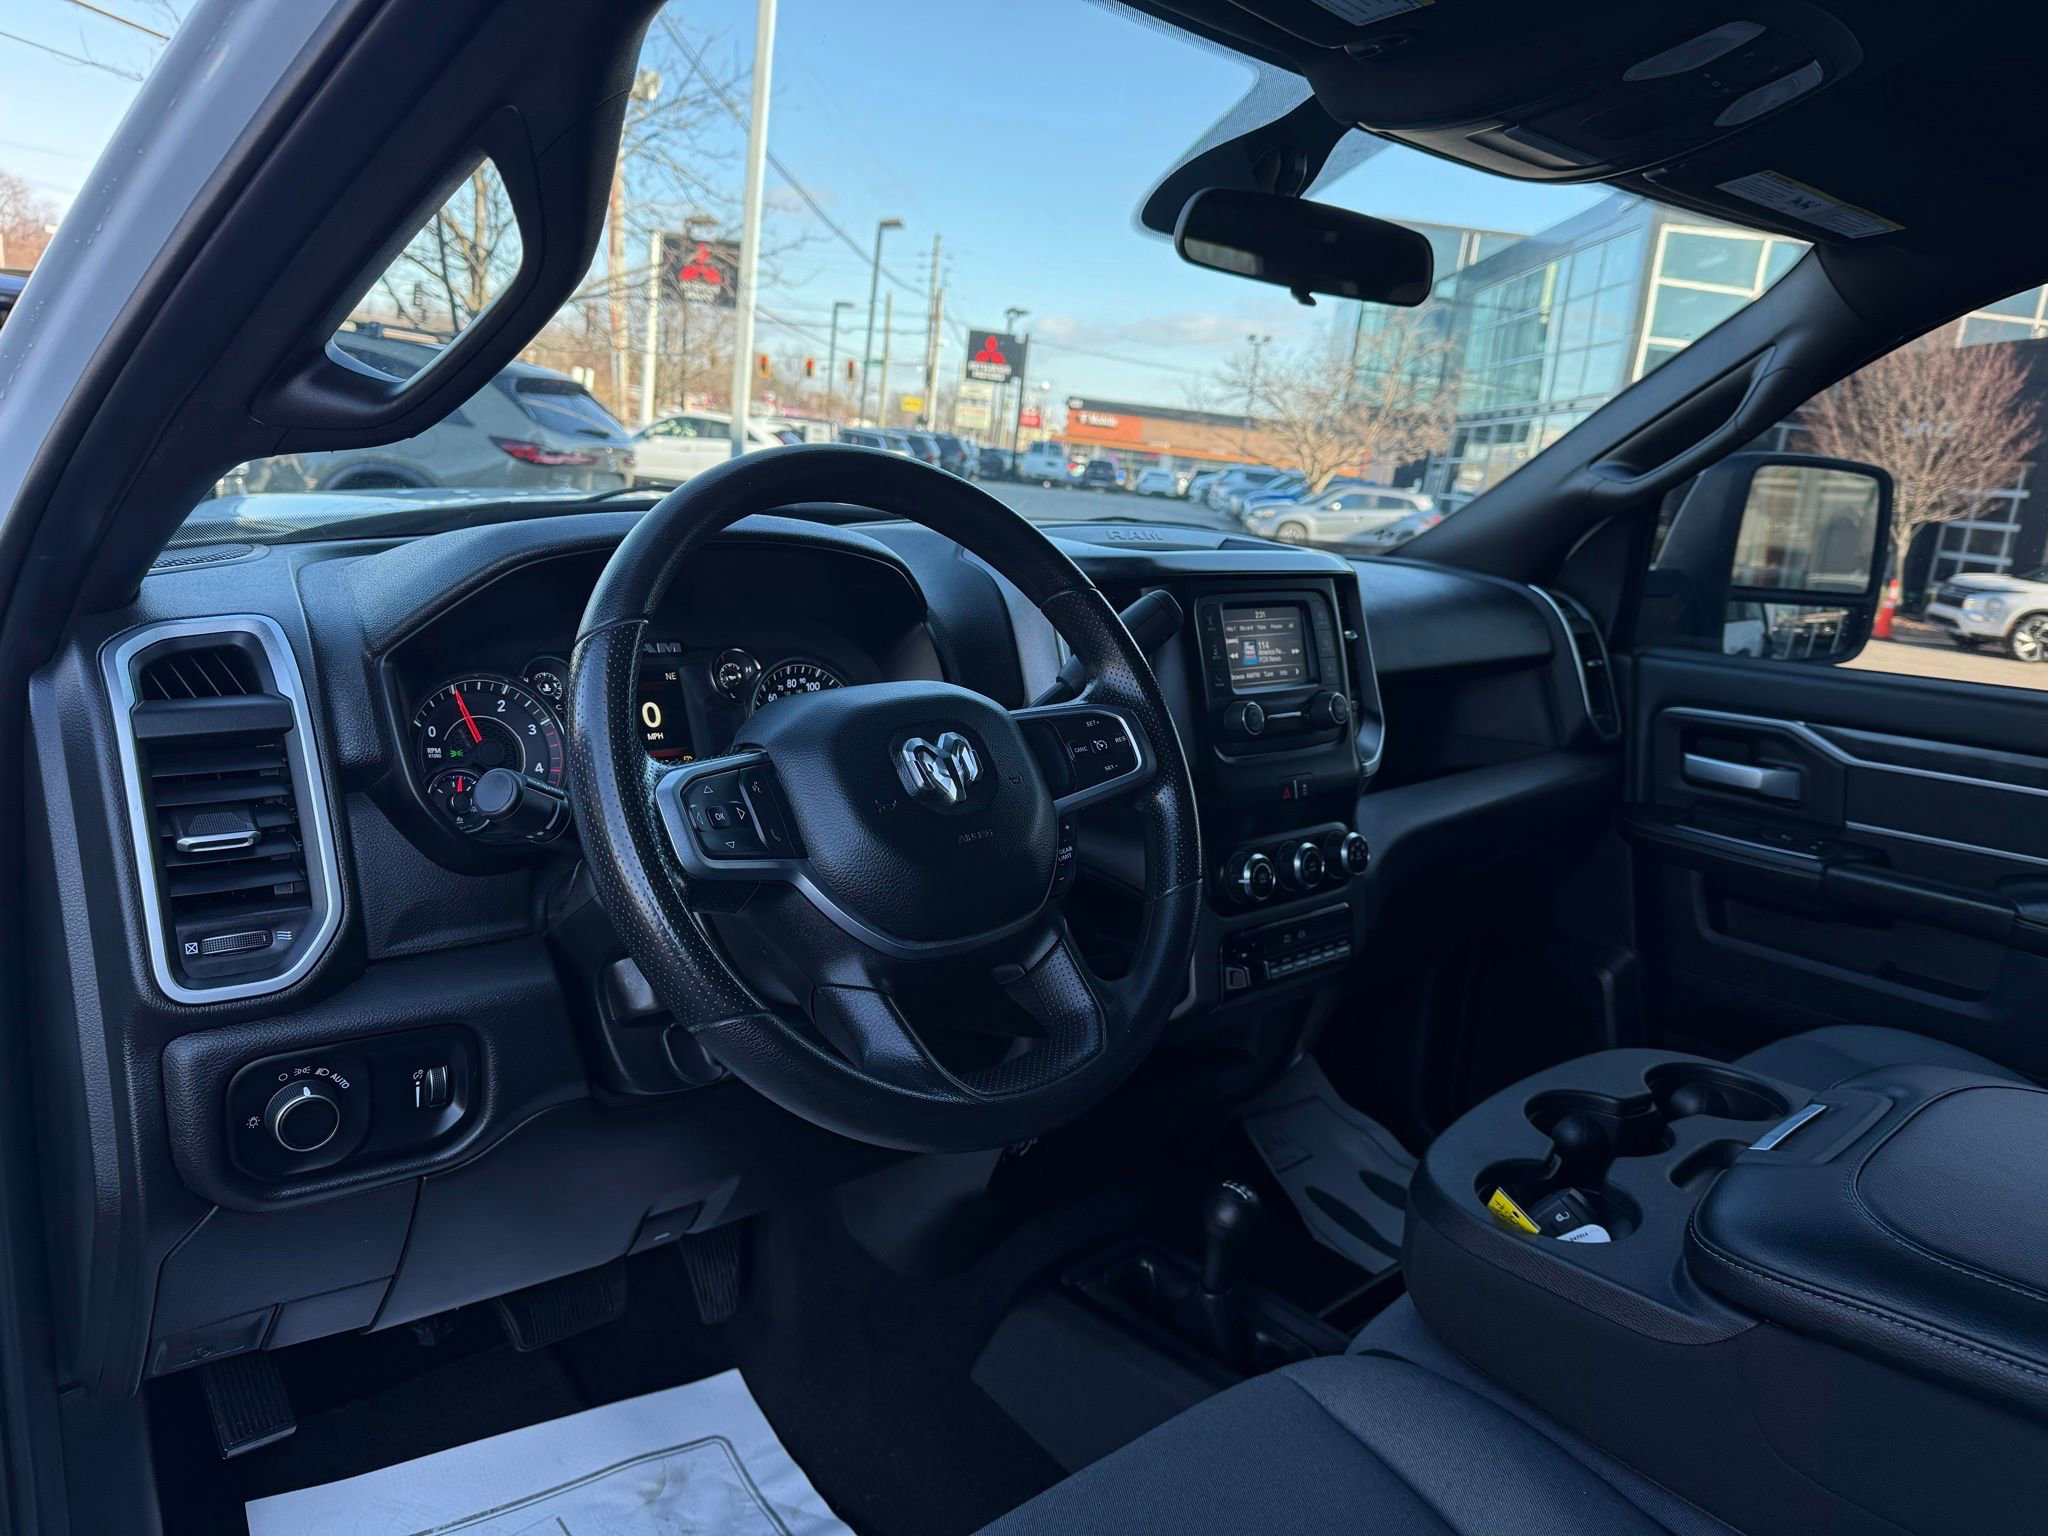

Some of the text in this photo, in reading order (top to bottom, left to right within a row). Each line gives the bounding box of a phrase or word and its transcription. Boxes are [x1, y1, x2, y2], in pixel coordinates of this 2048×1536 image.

[1106, 530, 1163, 541] RAM
[642, 642, 682, 654] AM
[665, 672, 677, 681] NE
[786, 678, 797, 688] 80
[806, 681, 821, 691] 100
[497, 699, 506, 713] 2
[642, 701, 662, 728] 0
[427, 726, 436, 737] 0
[528, 724, 537, 736] 3
[647, 732, 664, 740] MPH
[534, 762, 544, 774] 4
[330, 1073, 350, 1089] AUTO
